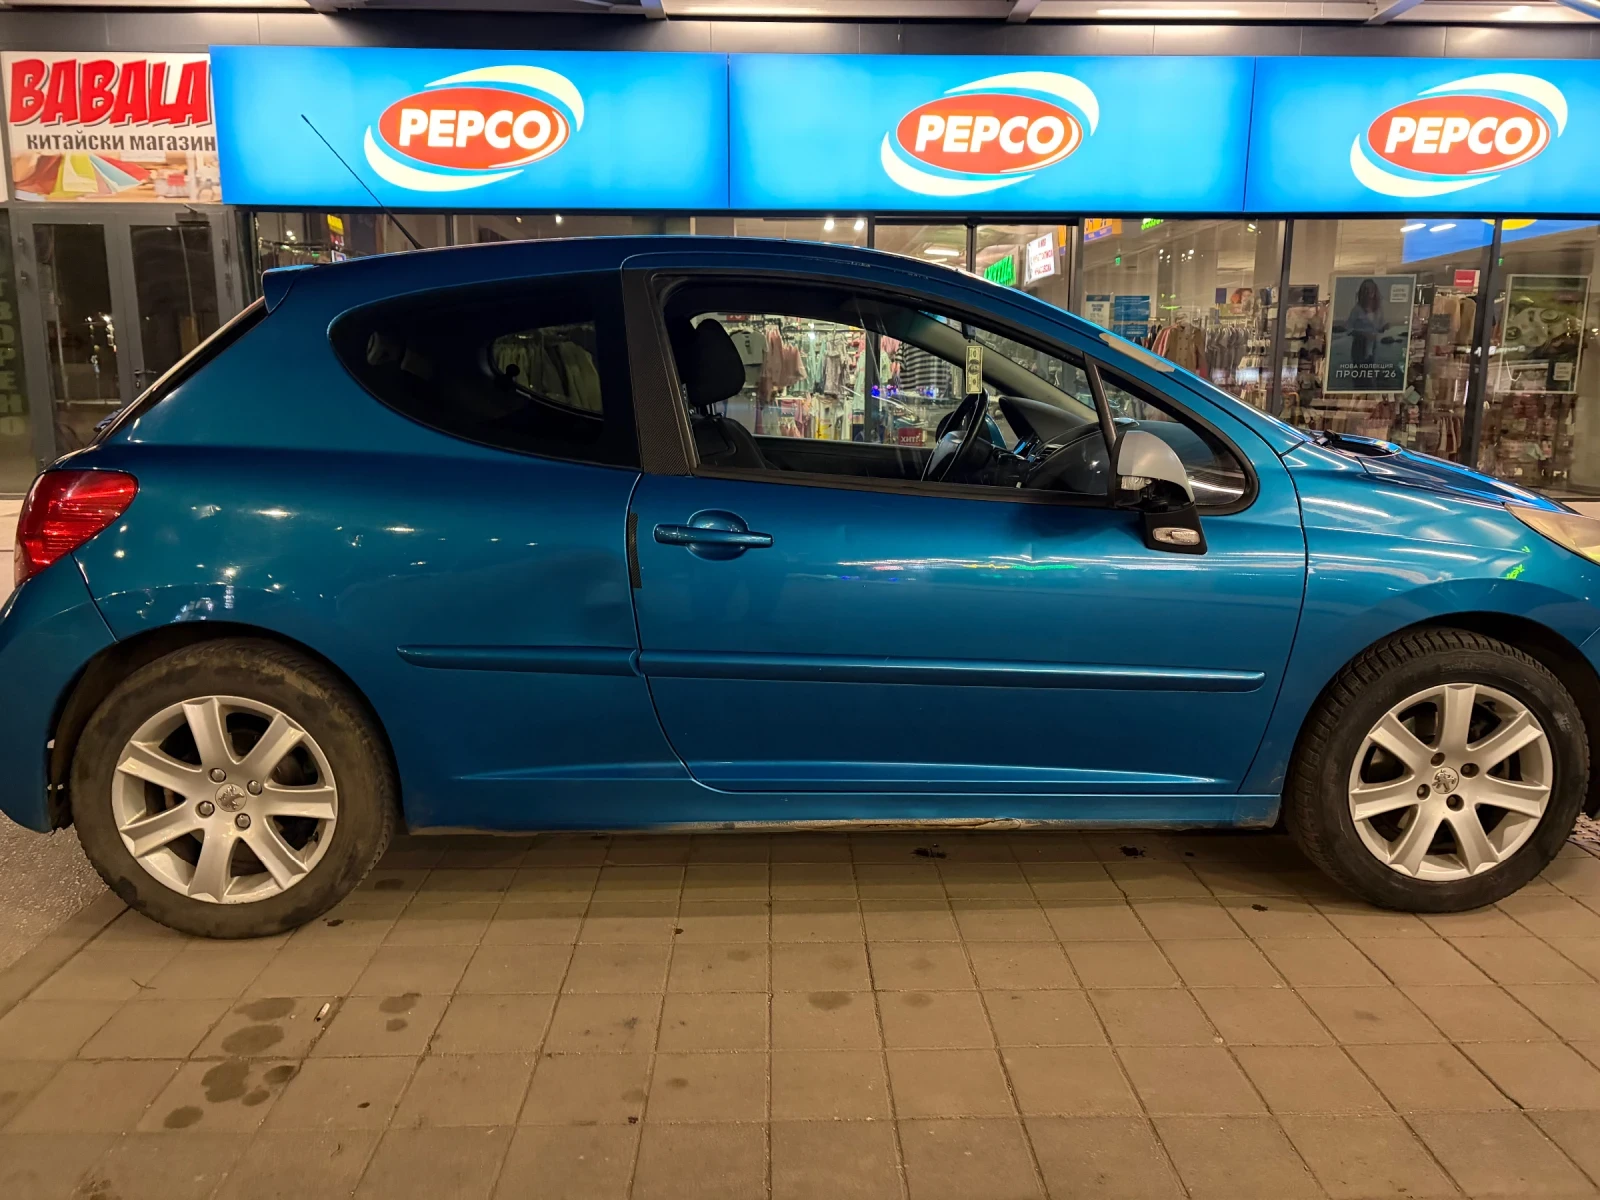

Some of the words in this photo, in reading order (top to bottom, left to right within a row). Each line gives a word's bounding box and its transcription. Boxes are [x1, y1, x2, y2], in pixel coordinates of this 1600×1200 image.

[9, 58, 212, 127] BABALA
[26, 130, 125, 151] китайски
[129, 134, 216, 151] магазин
[398, 108, 551, 149] PEPCO
[914, 114, 1065, 155] PEPCO
[1384, 116, 1533, 155] PEPCO
[1335, 370, 1381, 379] ПРОЛЕТ
[1382, 370, 1397, 379] '26
